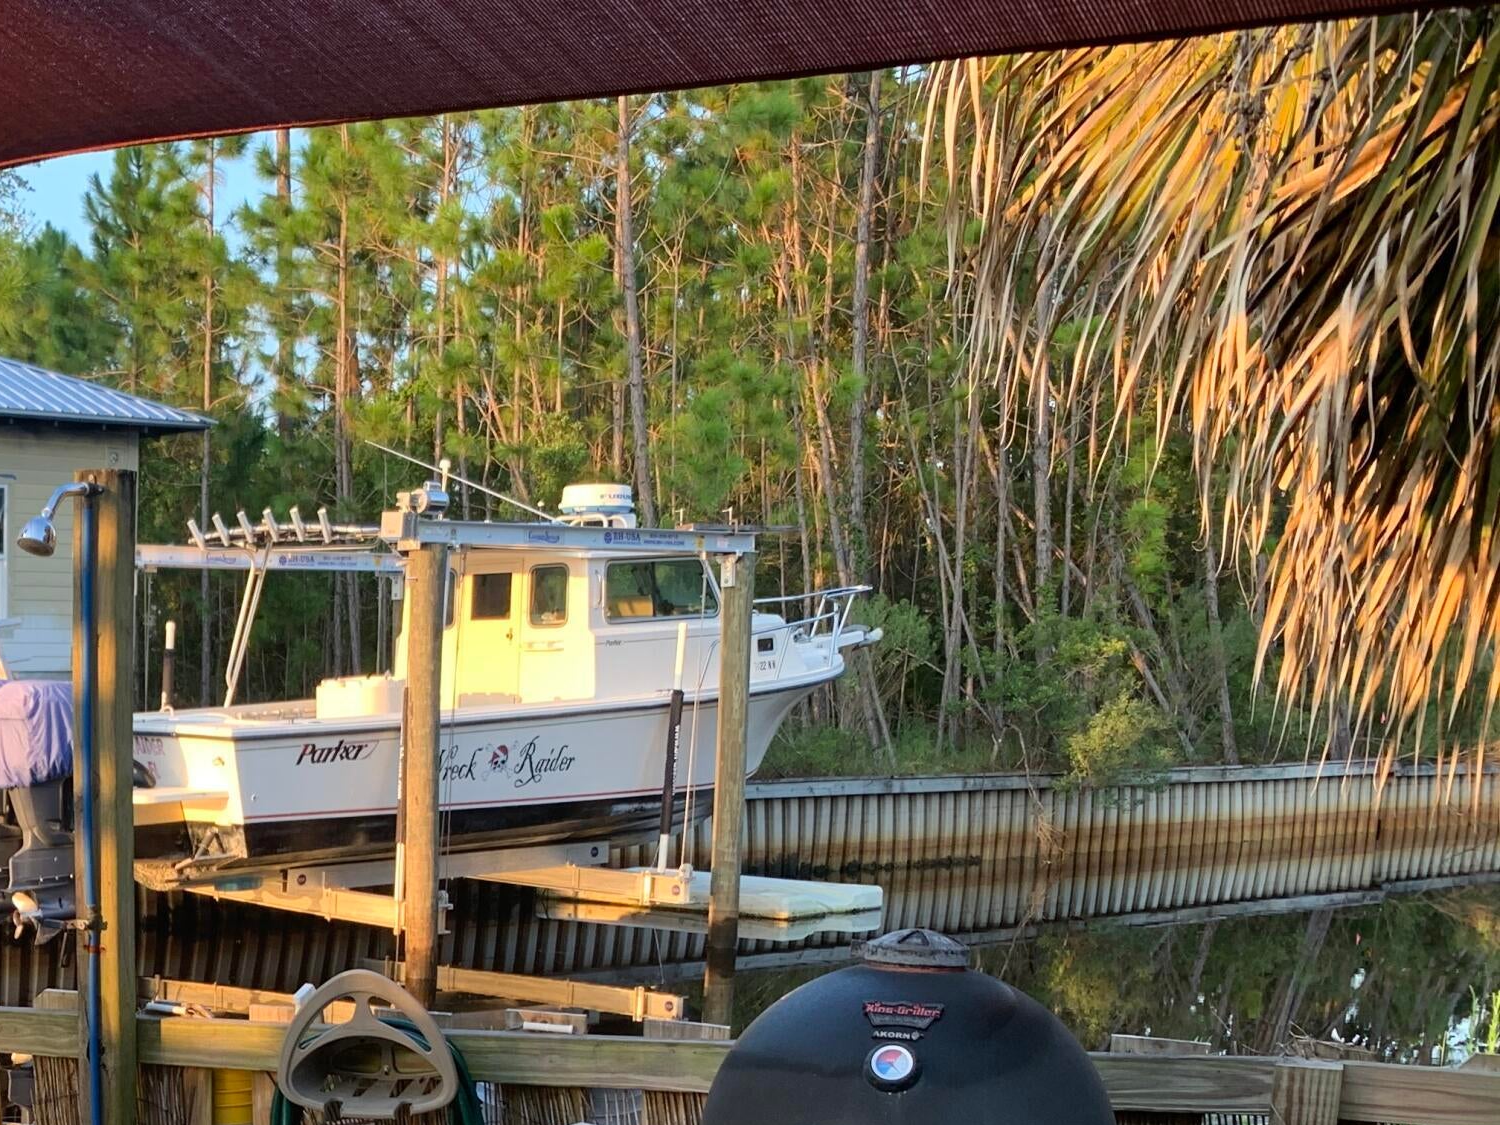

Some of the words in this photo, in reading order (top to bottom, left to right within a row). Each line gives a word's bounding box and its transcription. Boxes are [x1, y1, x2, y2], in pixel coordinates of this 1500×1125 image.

[134, 736, 165, 756] AIDER
[296, 739, 368, 765] Parker
[514, 735, 575, 788] Raider
[873, 1031, 910, 1039] AKORN
